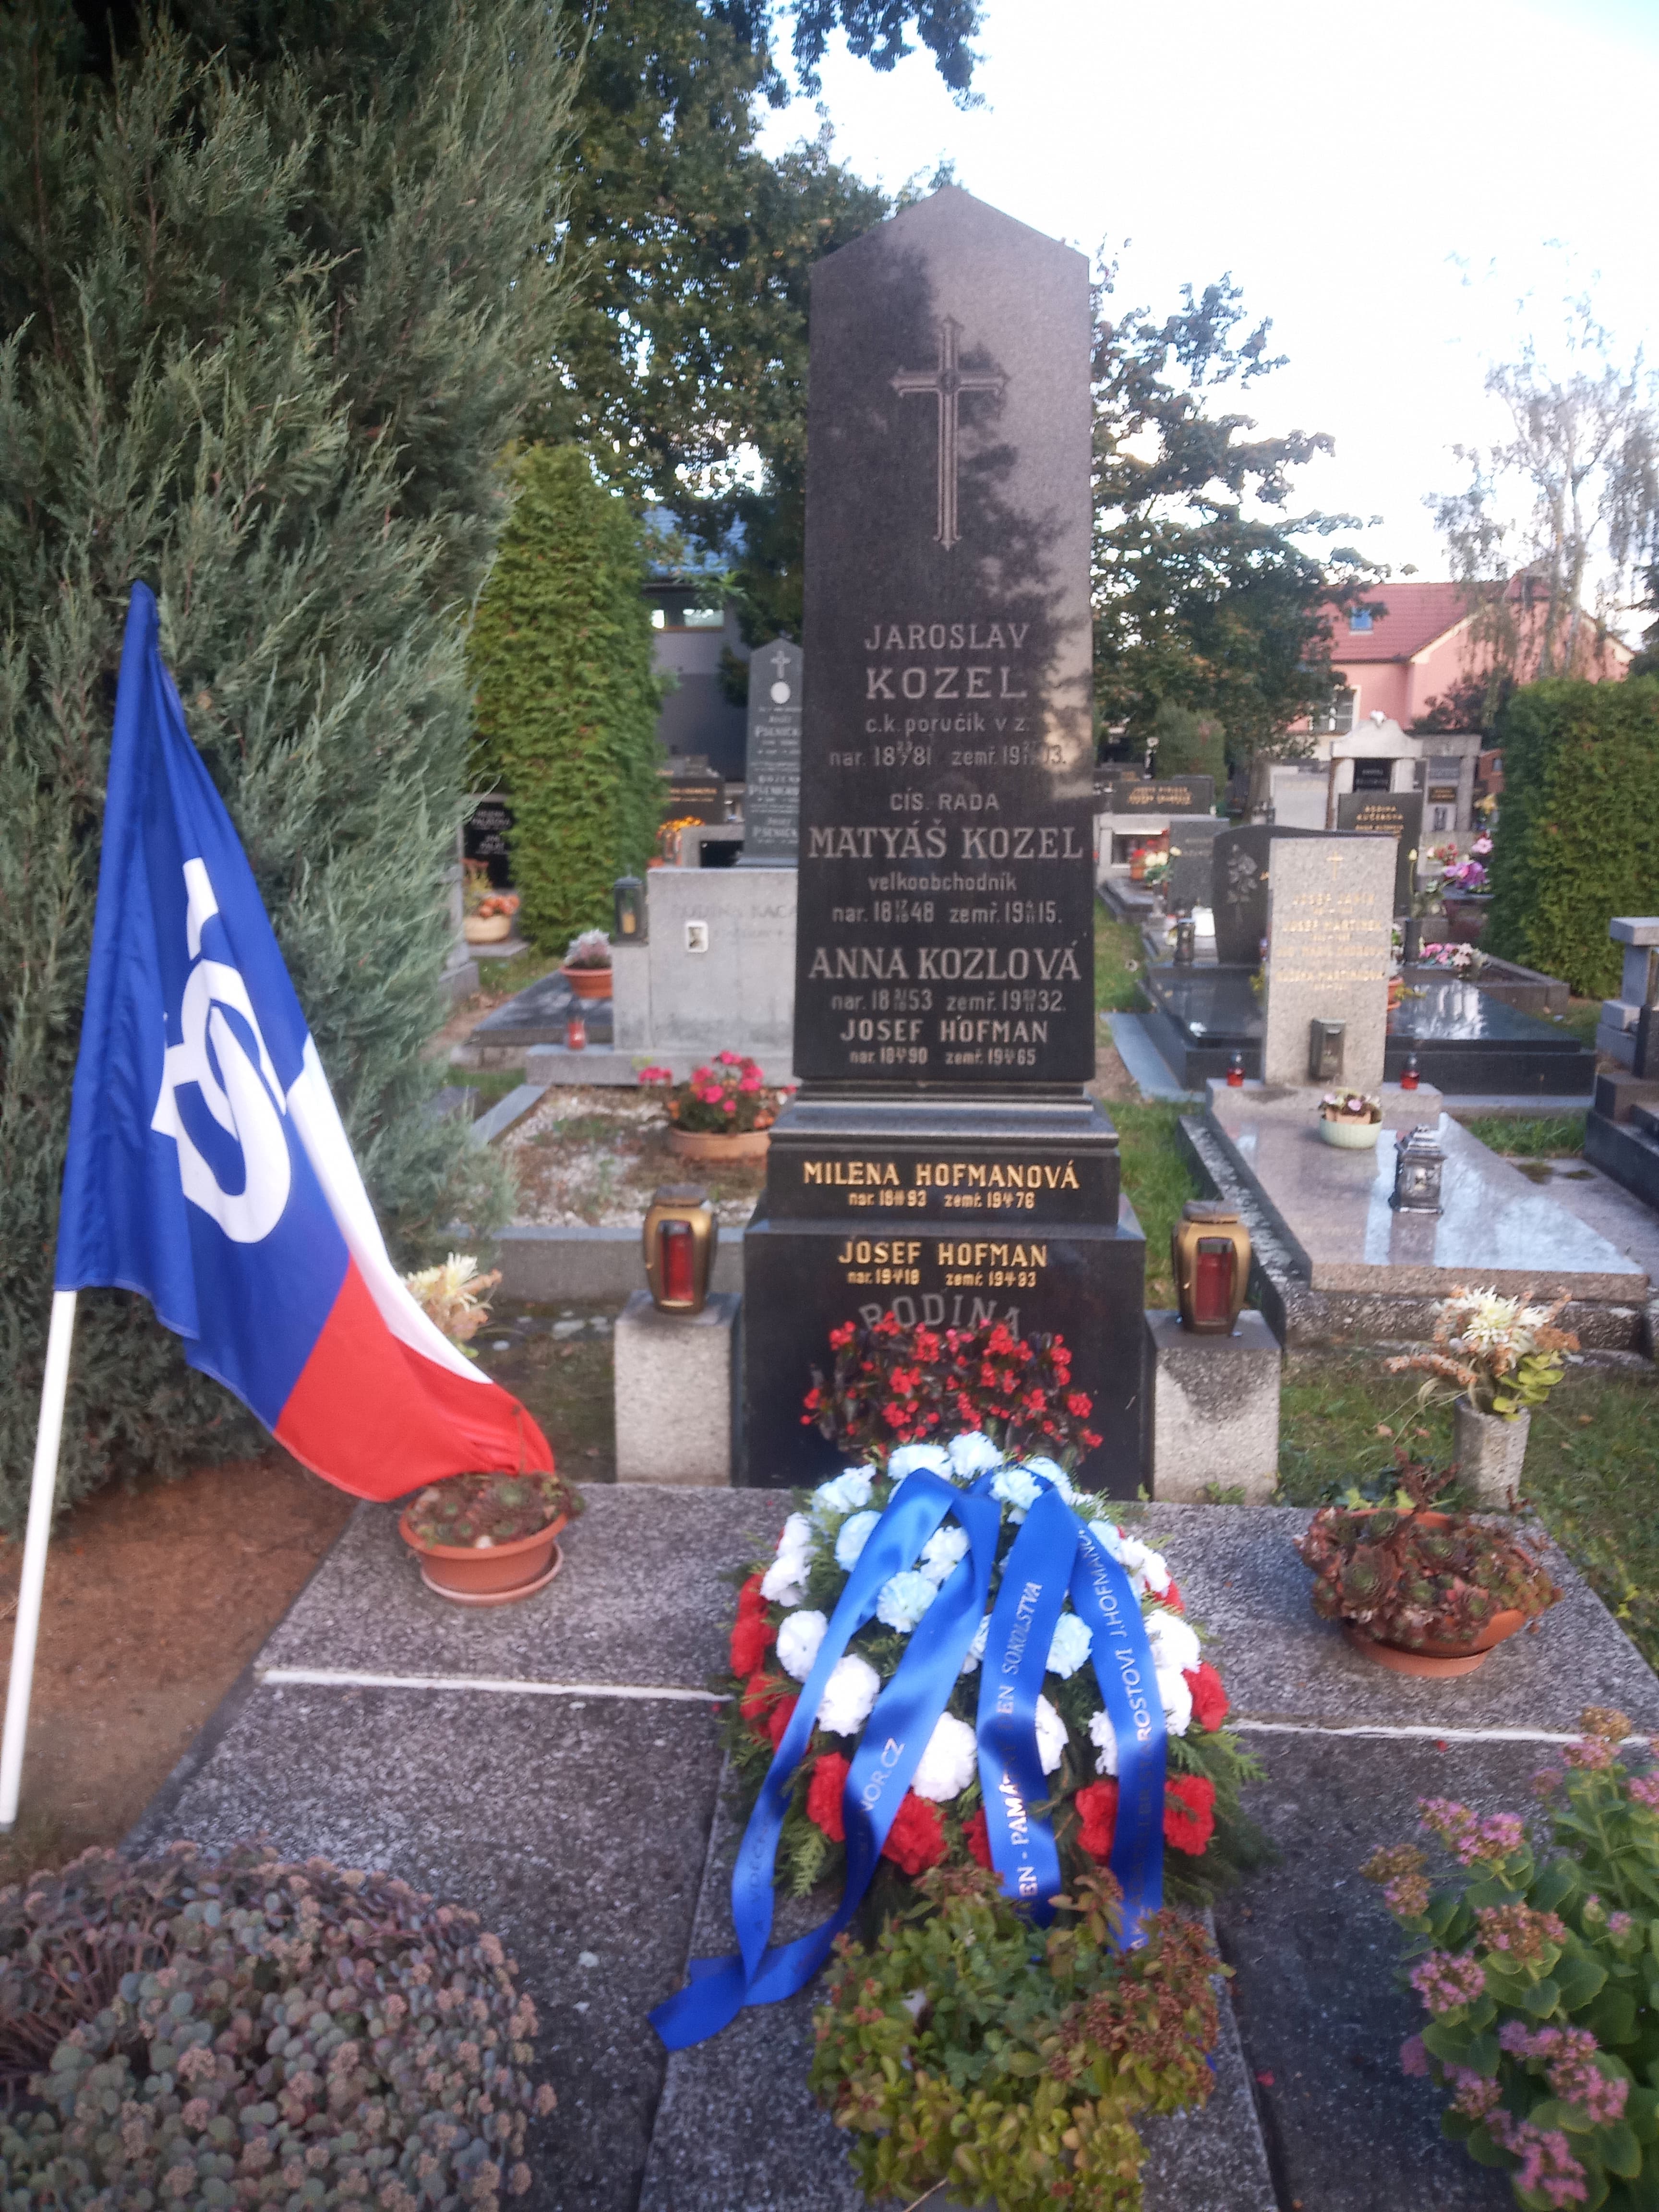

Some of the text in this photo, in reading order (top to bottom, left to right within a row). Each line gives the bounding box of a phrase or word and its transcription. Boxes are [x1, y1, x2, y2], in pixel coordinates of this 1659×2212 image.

[865, 623, 1030, 650] JAROSLAV
[866, 666, 1028, 699] KOZEL
[996, 718, 1007, 732] v
[939, 793, 999, 811] RADA
[808, 819, 1083, 859] MATYÁŠ KOZEL
[832, 906, 868, 923] nar.
[949, 901, 1000, 924] zemř.
[808, 939, 1082, 981] ANNA KOZLOVÁ
[830, 994, 867, 1011] nar.
[946, 991, 997, 1011] zemř.
[839, 1019, 1049, 1044] JOSEF HOFMAN
[803, 1159, 1080, 1190] MILENA HOFMANOVÁ
[838, 1240, 1049, 1268] JOSEF HOFMAN
[858, 1292, 1022, 1341] RODINA
[1001, 1580, 1044, 1675] SOKOLSTVA
